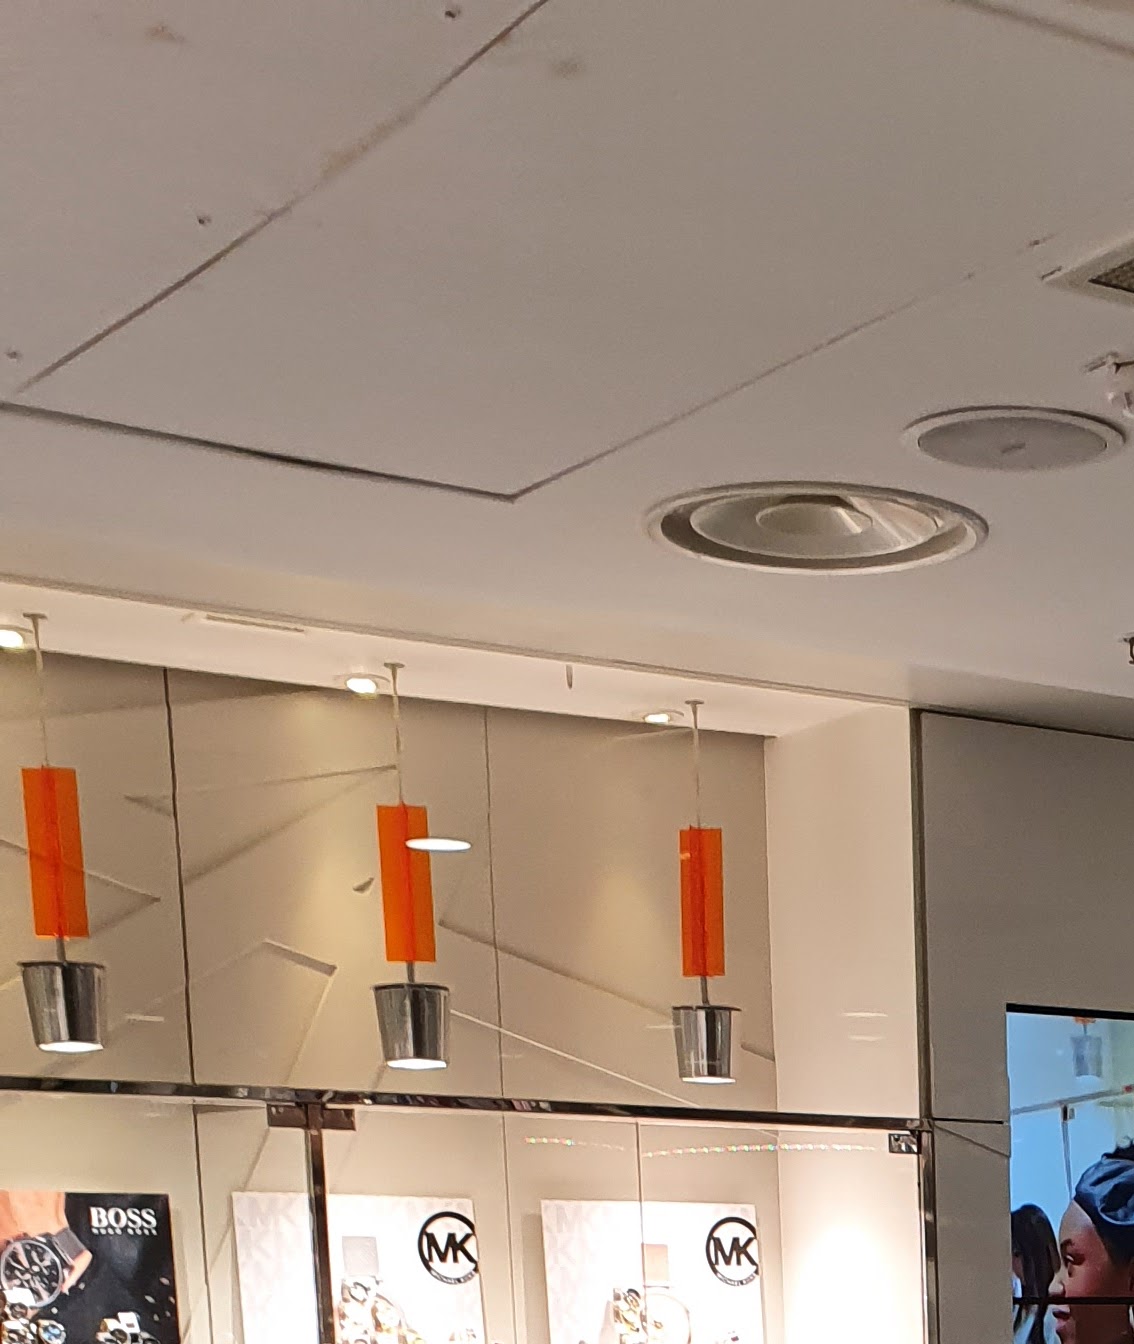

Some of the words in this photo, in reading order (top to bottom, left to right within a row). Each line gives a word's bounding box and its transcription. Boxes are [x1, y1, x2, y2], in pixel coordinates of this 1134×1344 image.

[89, 1206, 157, 1229] BOSS
[425, 1232, 477, 1264] MK
[712, 1237, 758, 1266] MK
